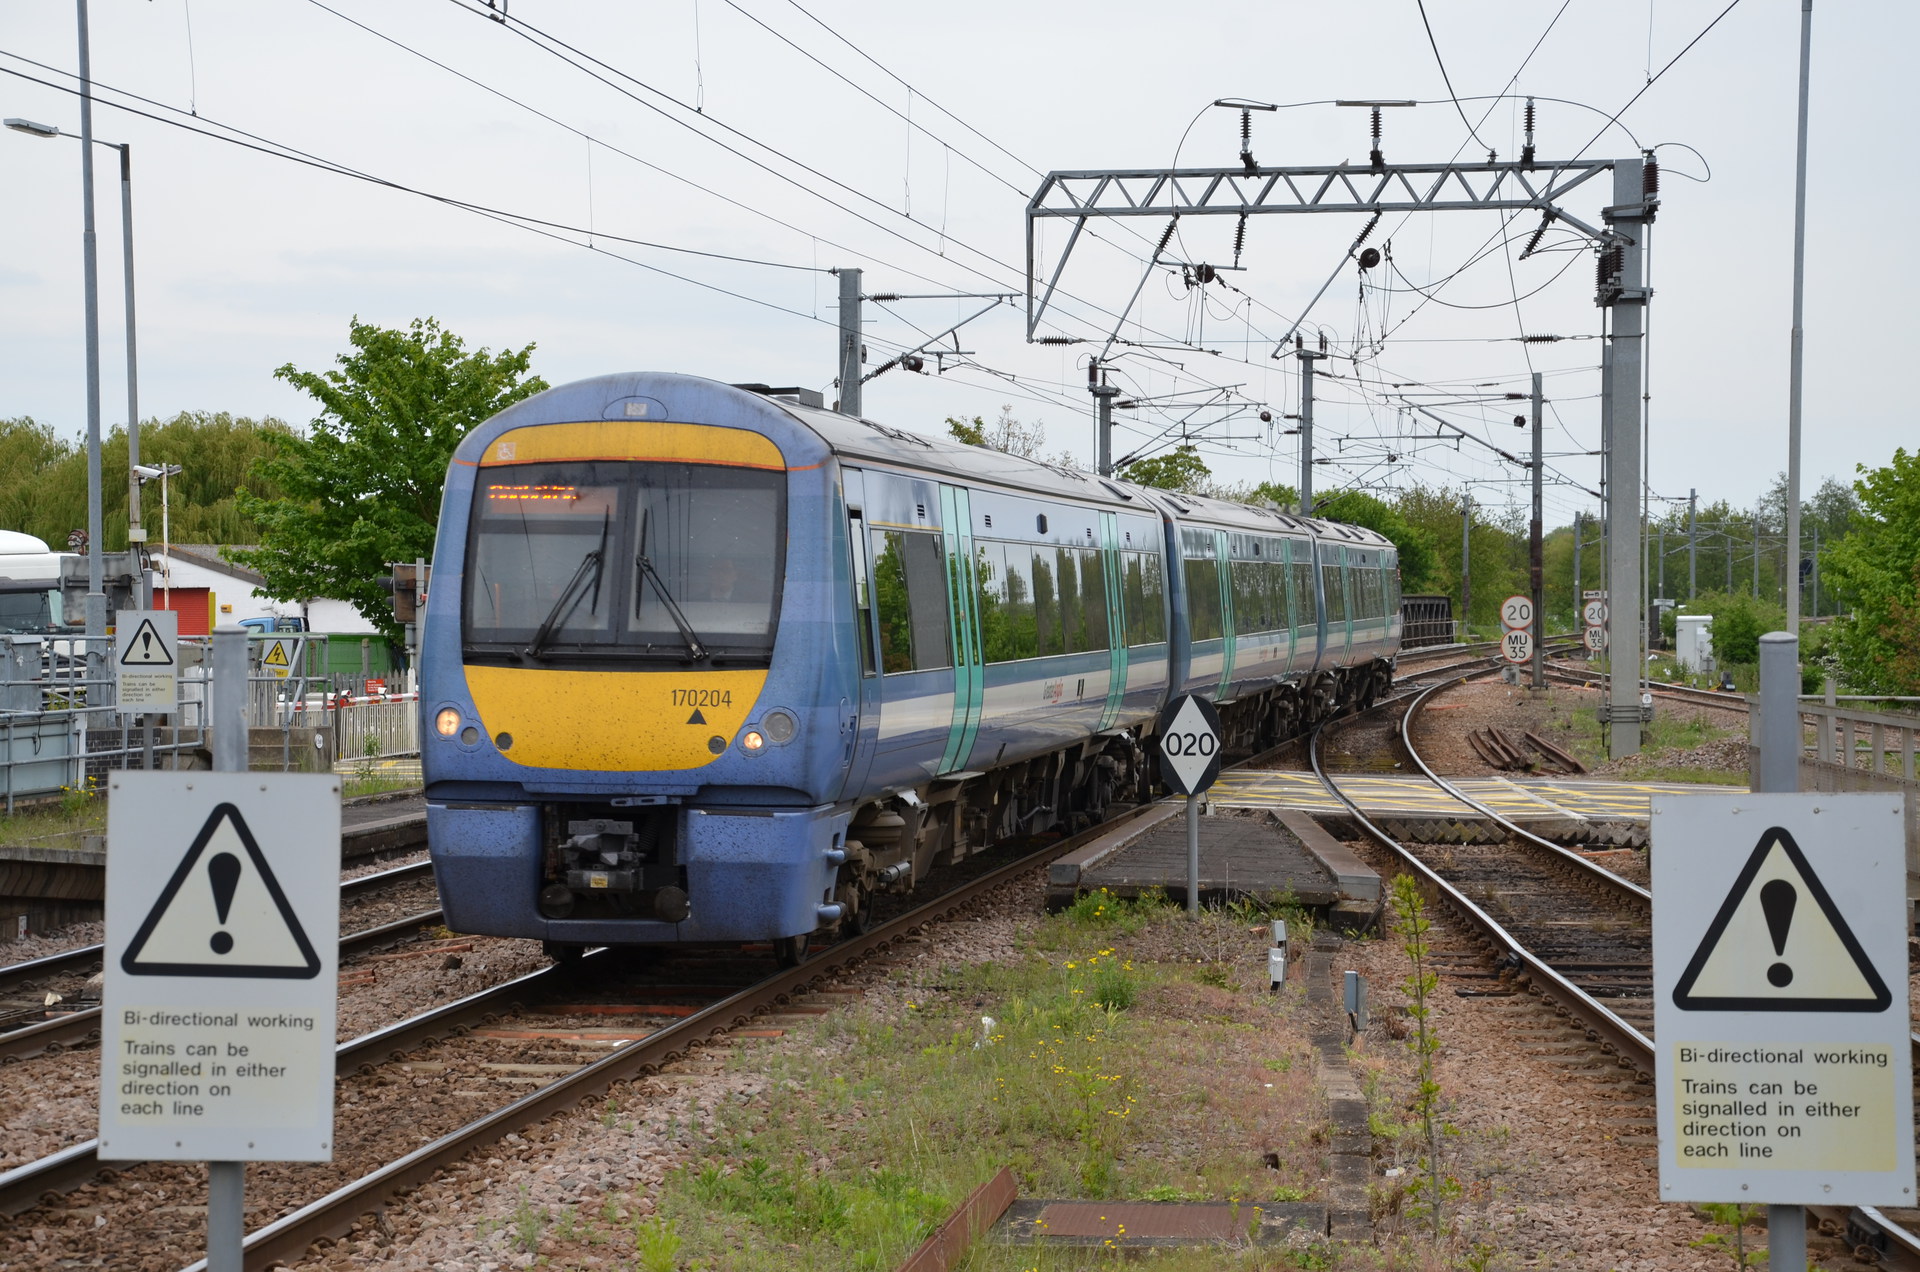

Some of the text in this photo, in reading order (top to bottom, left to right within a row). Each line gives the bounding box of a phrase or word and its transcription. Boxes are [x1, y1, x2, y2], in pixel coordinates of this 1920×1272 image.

[1507, 604, 1530, 620] 20
[1508, 634, 1528, 646] MU
[1510, 646, 1526, 659] 35
[671, 689, 732, 708] 170204
[1166, 732, 1215, 756] 020
[124, 1011, 314, 1031] Bi-directional working
[124, 1040, 249, 1057] Trains can be
[1680, 1048, 1888, 1067] Bi-directional working
[122, 1061, 287, 1078] signalled in either
[121, 1081, 231, 1096] direction on
[1681, 1079, 1818, 1095] Trains can be
[121, 1100, 204, 1116] each line
[1682, 1101, 1861, 1118] signalled in either
[1683, 1122, 1801, 1137] direction on
[1683, 1142, 1773, 1158] each line
